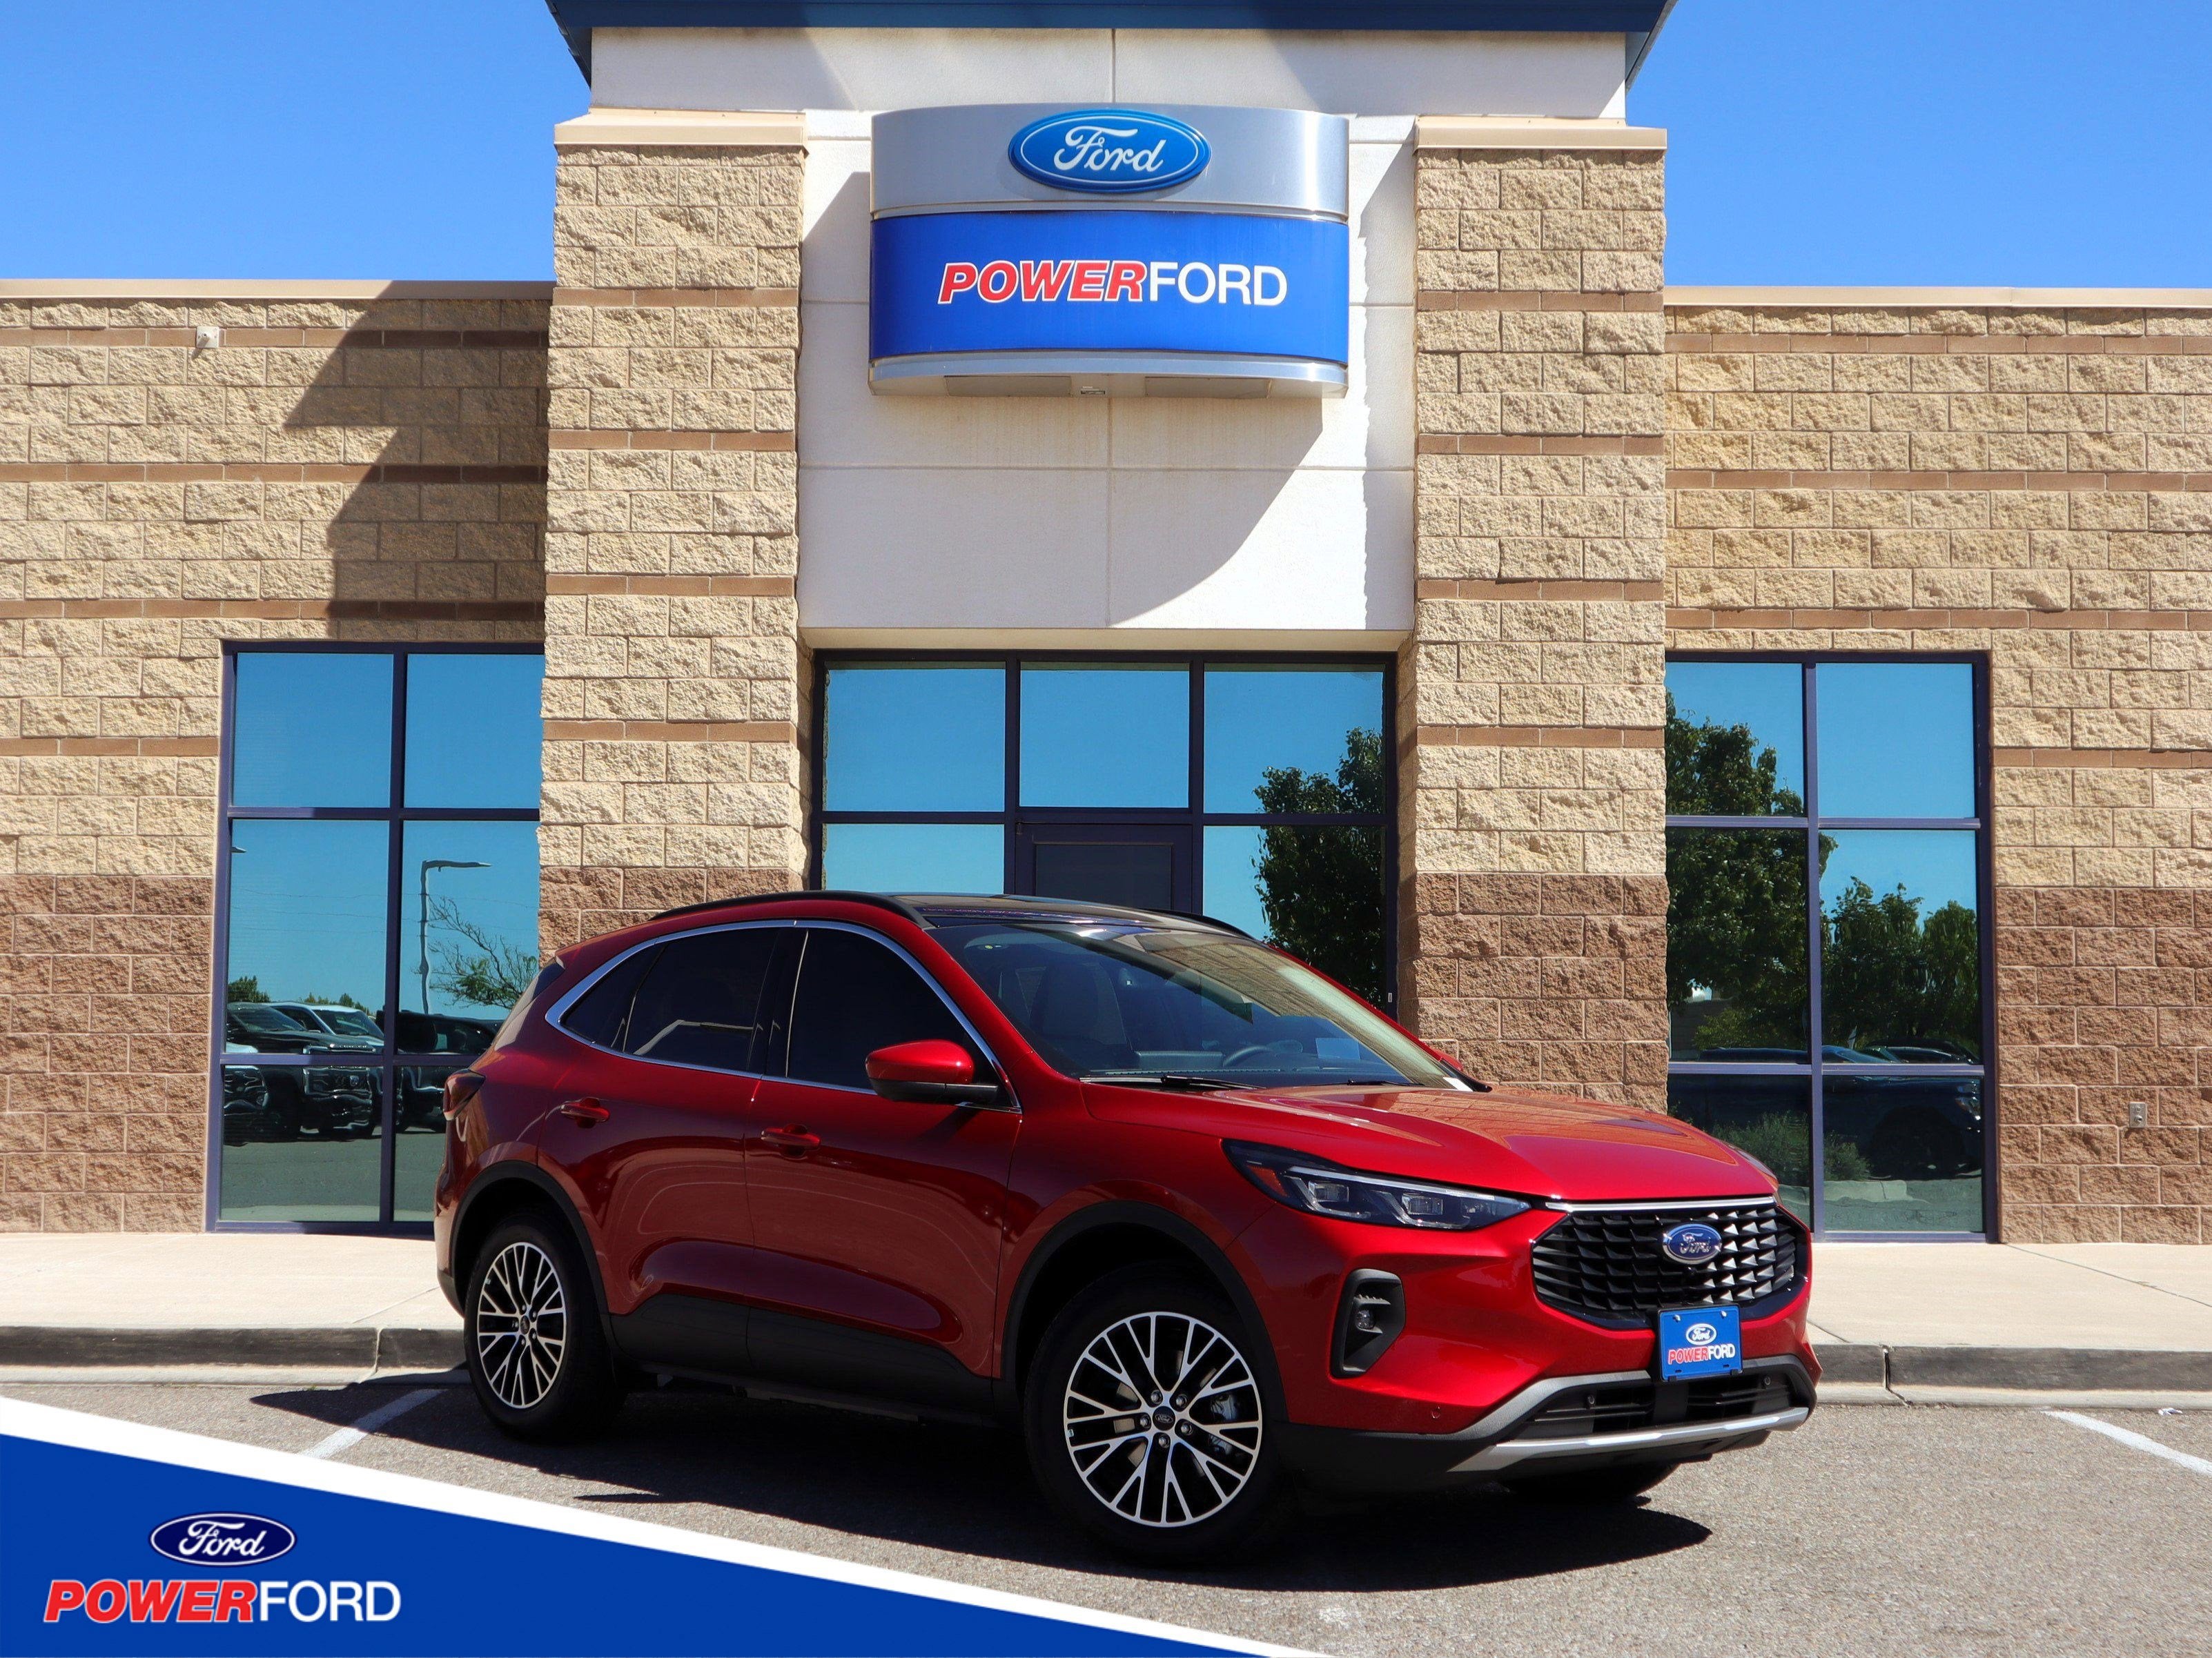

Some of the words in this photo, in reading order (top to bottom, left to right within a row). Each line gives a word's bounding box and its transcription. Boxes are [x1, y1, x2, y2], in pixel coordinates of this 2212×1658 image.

[1054, 125, 1166, 173] Ford
[937, 259, 1288, 306] POWERFORD
[1680, 1232, 1712, 1254] Ford
[1692, 1326, 1711, 1342] Ford
